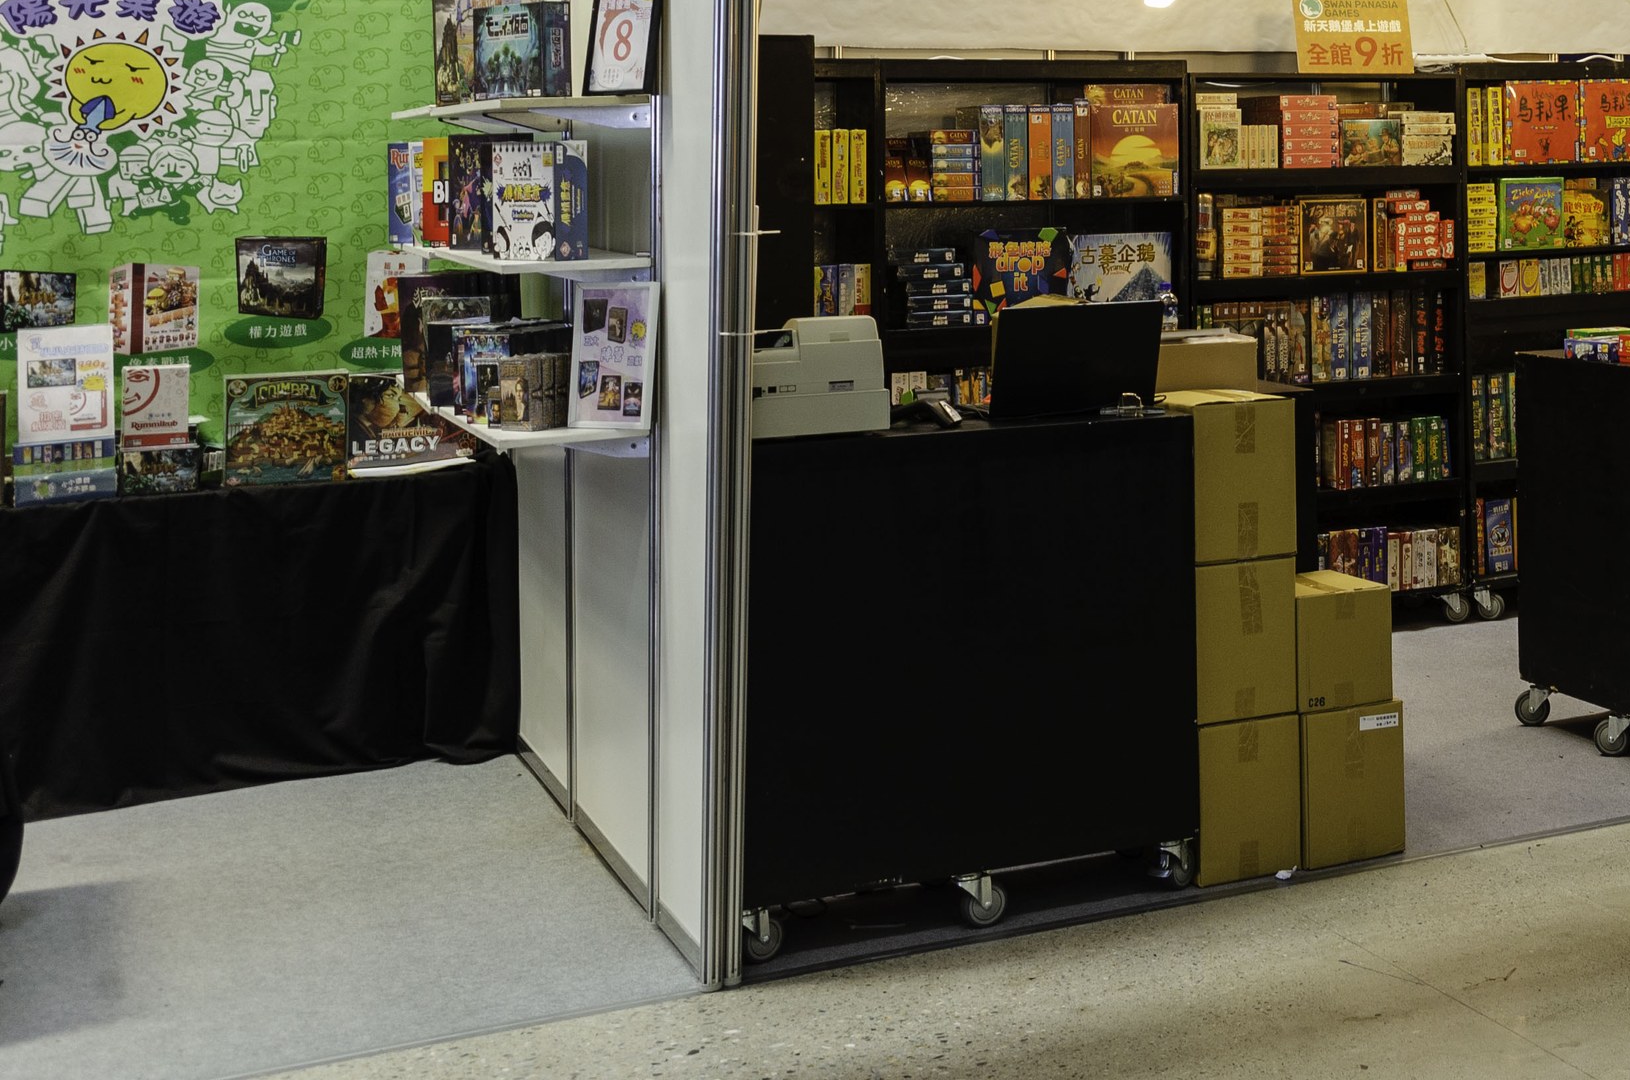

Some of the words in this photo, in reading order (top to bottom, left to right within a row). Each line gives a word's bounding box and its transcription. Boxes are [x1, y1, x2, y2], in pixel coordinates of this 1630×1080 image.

[1323, 0, 1352, 8] SWAN
[1354, 0, 1398, 9] PANASIA
[1325, 9, 1360, 17] GAMES
[1303, 19, 1401, 32] 新天鵝堡桌上遊戲
[613, 19, 633, 61] 8
[1307, 36, 1403, 67] 全館9折
[1113, 88, 1144, 99] CATAN
[1112, 109, 1157, 125] CATAN
[1009, 138, 1020, 168] CATAN
[1056, 137, 1065, 167] CATAN
[1511, 187, 1535, 200] Zicke
[261, 244, 287, 256] GAME
[1079, 242, 1155, 264] 古墓企鵝
[259, 255, 296, 267] THRONES
[996, 255, 1045, 273] drop
[1013, 273, 1028, 291] it
[249, 323, 307, 339] 權力遊戲
[1337, 311, 1345, 359] SKYLINERS
[1360, 310, 1368, 358] SKYLINERS
[258, 382, 317, 401] COIMBRA
[352, 435, 440, 455] LEGACY
[1308, 697, 1326, 708] C26
